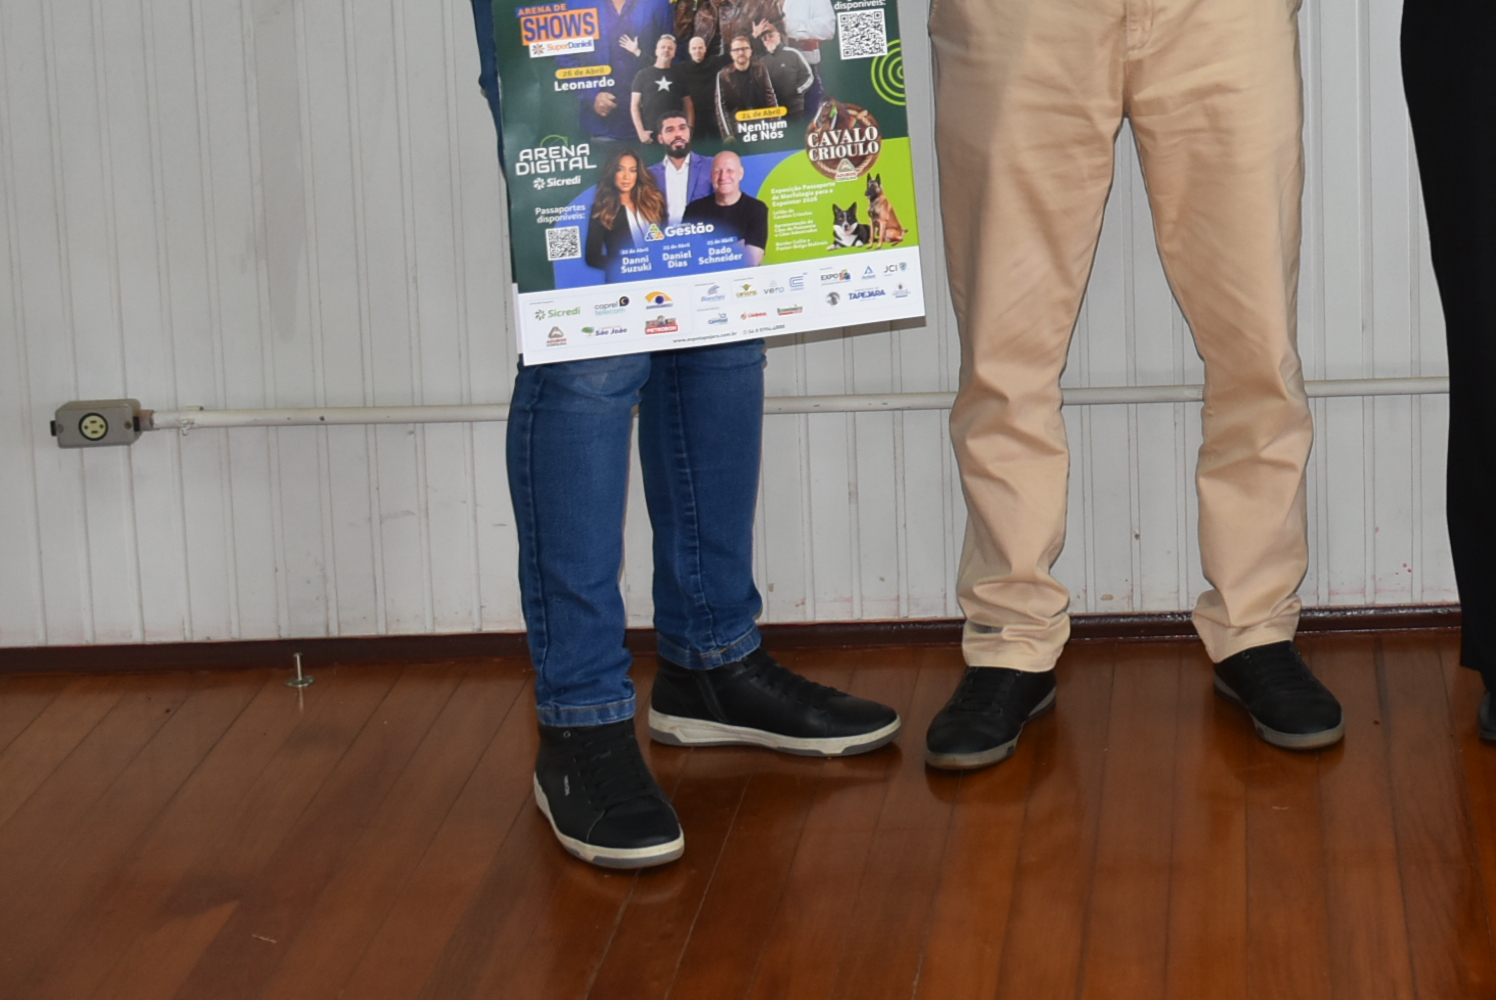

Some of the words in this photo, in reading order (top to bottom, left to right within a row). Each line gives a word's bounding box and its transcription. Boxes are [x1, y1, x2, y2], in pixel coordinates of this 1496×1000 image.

[518, 5, 552, 16] ARENA
[523, 12, 595, 41] SHOWS
[554, 76, 615, 91] Leonardo
[763, 109, 781, 117] Abril
[738, 120, 787, 133] Nenhum
[743, 132, 758, 142] de
[807, 126, 878, 148] CAVALO
[520, 143, 590, 161] ARENA
[809, 141, 879, 162] CRIOULO
[515, 156, 597, 176] DIGITAL
[546, 175, 581, 187] Sicredi
[535, 205, 586, 215] Passaportes
[665, 222, 714, 237] Gestão
[662, 250, 692, 261] Daniel
[708, 246, 732, 256] Dado
[622, 255, 649, 265] Danni
[668, 260, 688, 268] Dias
[698, 252, 743, 265] Schneider
[621, 263, 652, 274] Suzuki
[884, 264, 898, 273] JCI
[764, 286, 785, 294] vero
[848, 290, 886, 300] TAPEJARA
[594, 301, 618, 311] coprel
[548, 307, 581, 318] Sicredi
[595, 308, 626, 316] telecom
[595, 327, 609, 336] São
[611, 326, 627, 335] João
